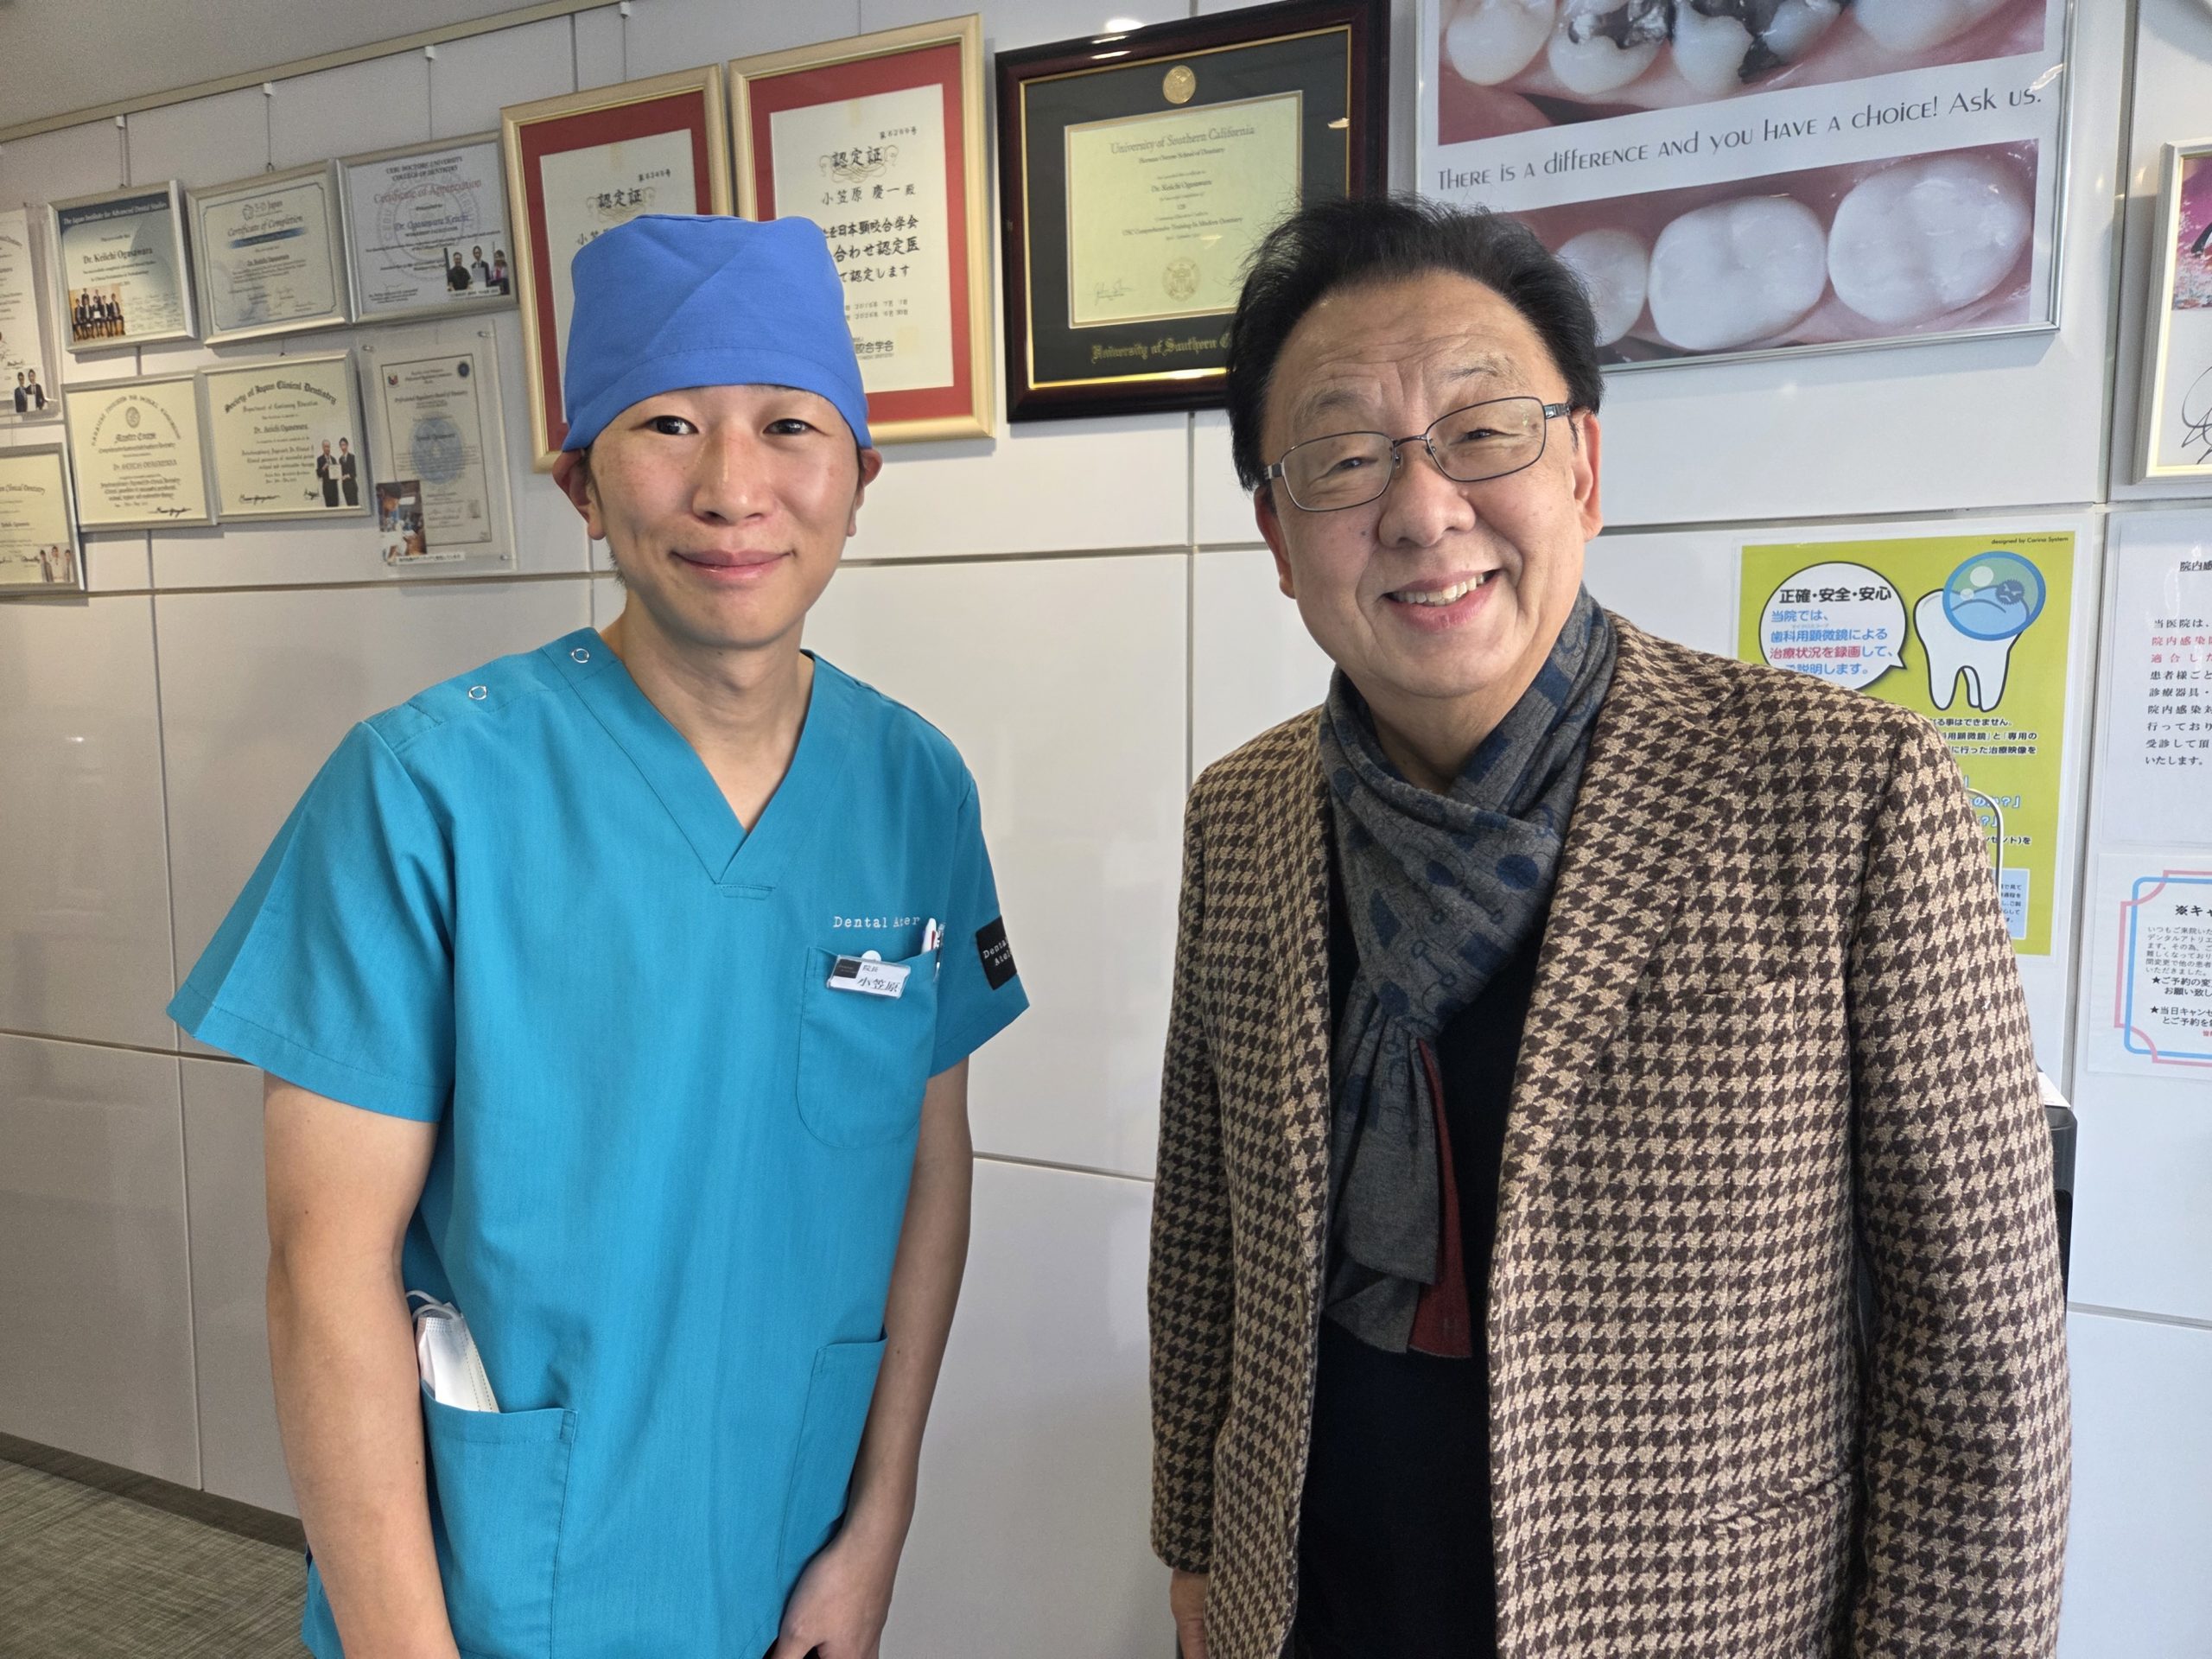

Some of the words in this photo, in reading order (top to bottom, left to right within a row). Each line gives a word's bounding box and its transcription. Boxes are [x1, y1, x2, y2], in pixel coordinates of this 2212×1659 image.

[1109, 141, 1154, 155] University
[1156, 137, 1165, 148] of
[1166, 132, 1207, 147] Southern
[1209, 125, 1255, 140] California
[1500, 163, 1516, 182] is
[1948, 87, 1997, 115] Ask
[832, 146, 882, 168] 認定証
[597, 188, 643, 209] 認定証
[821, 186, 862, 206] 小笠原
[833, 236, 920, 263] 合わせ認定医
[839, 264, 910, 283] て認定します
[1091, 341, 1147, 365] University
[1151, 339, 1163, 355] of
[1162, 336, 1217, 356] Southern
[1779, 586, 1891, 603] 正確・安全・安心
[1771, 609, 1828, 622] 当院では、
[1770, 628, 1888, 643] 歯科用顕微鏡による
[1770, 645, 1892, 659] 治療状況を録画して、
[2145, 756, 2202, 766] いたします。
[833, 916, 887, 928] Dental
[857, 976, 900, 993] 小笠原
[2162, 976, 2212, 988] ご予約の変
[2163, 1016, 2212, 1027] とご予約を
